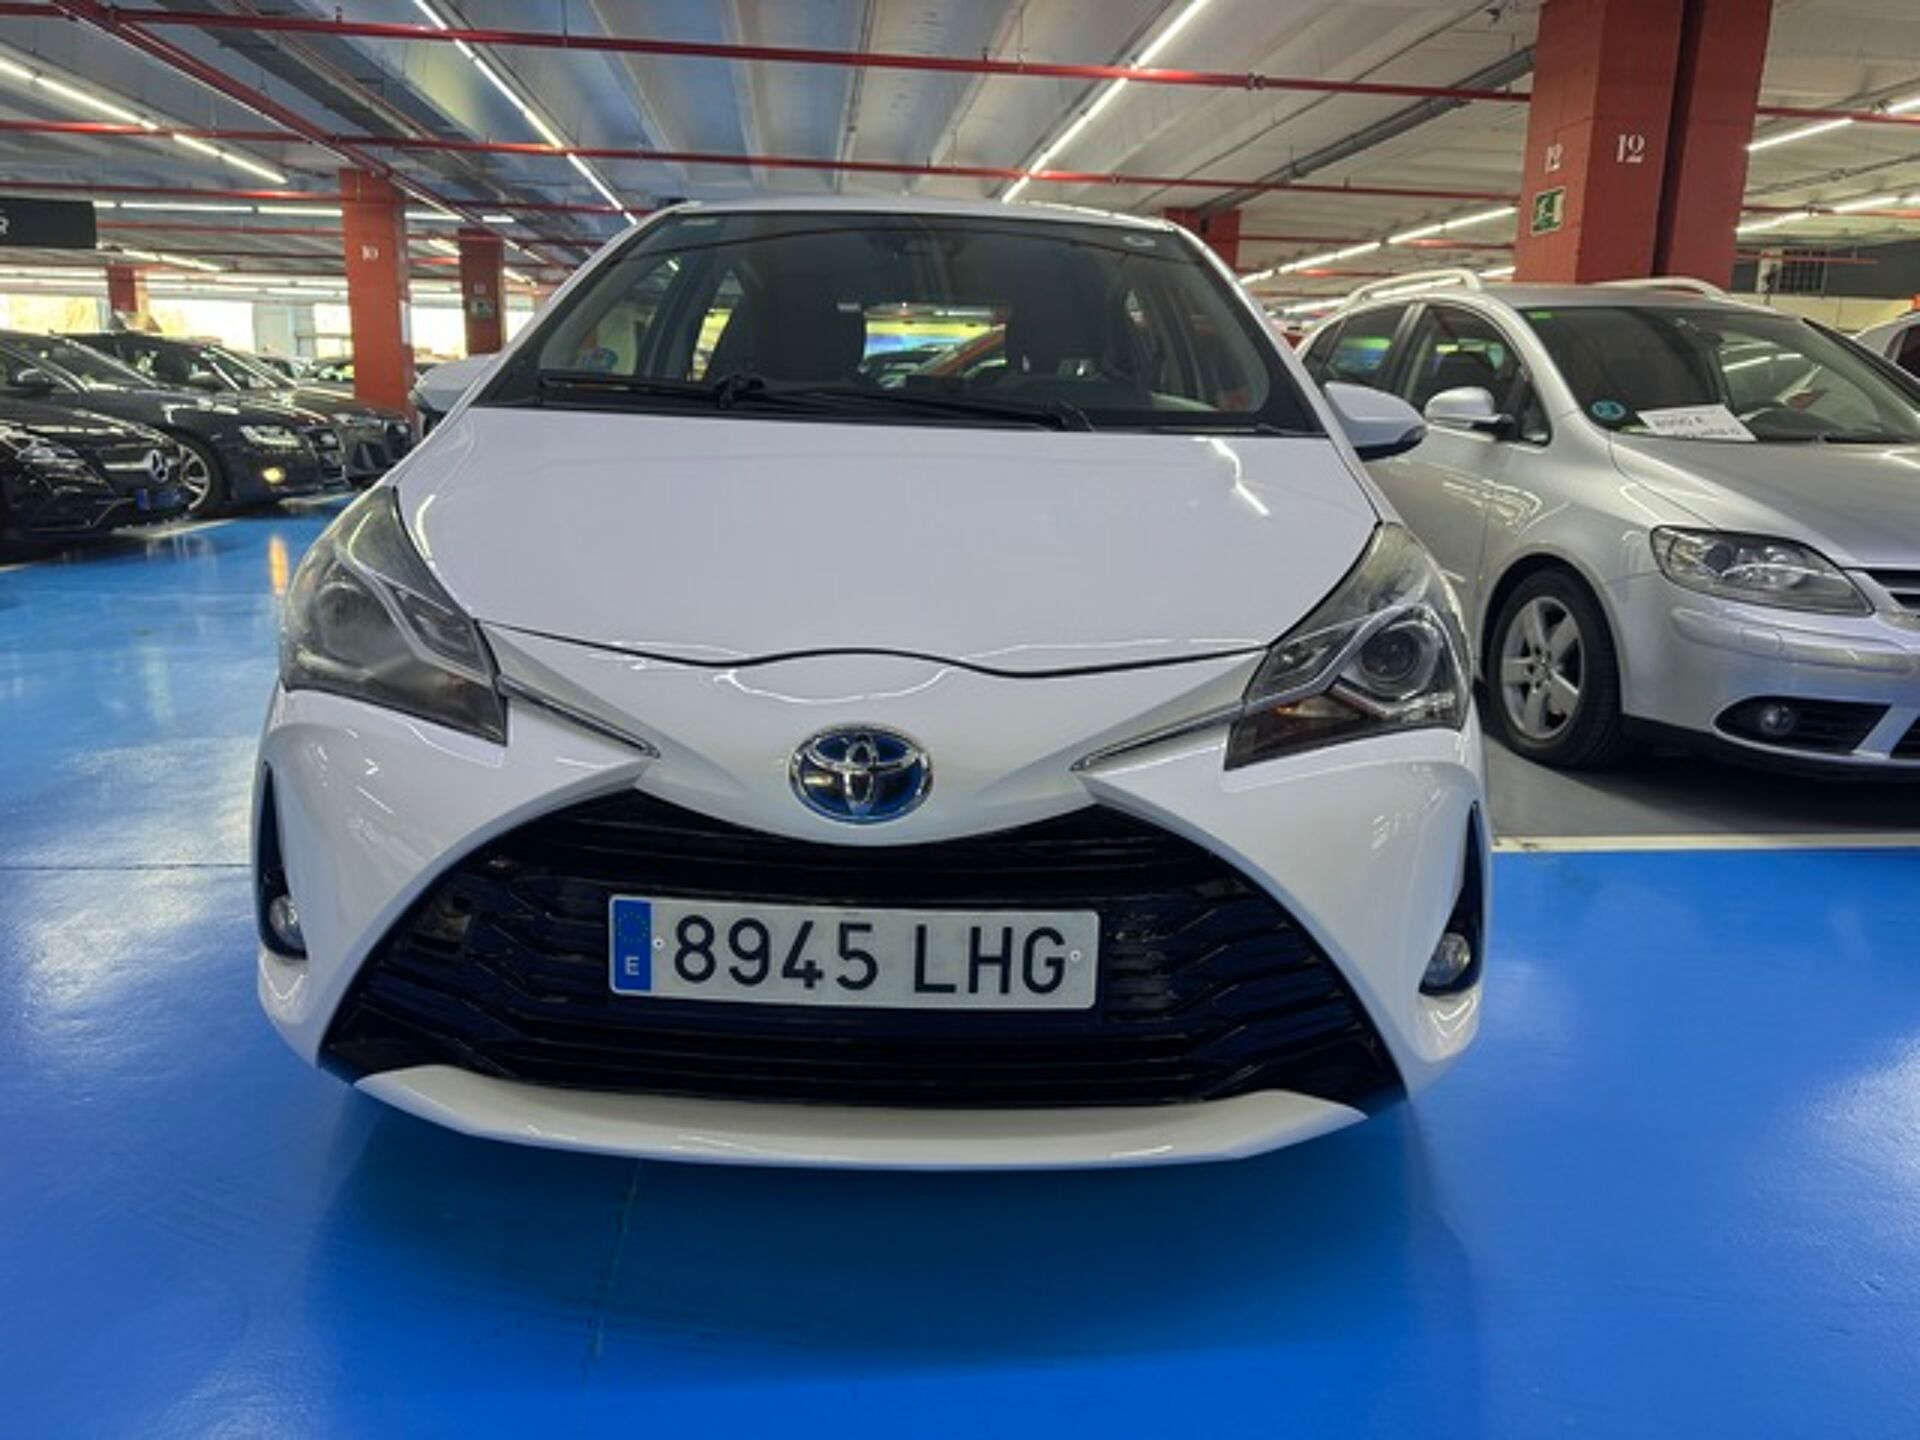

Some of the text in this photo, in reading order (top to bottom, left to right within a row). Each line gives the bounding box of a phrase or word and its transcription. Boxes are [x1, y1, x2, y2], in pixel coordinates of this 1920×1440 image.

[1616, 134, 1645, 163] 12
[624, 955, 641, 976] E
[674, 914, 1065, 995] 8945 LHG
